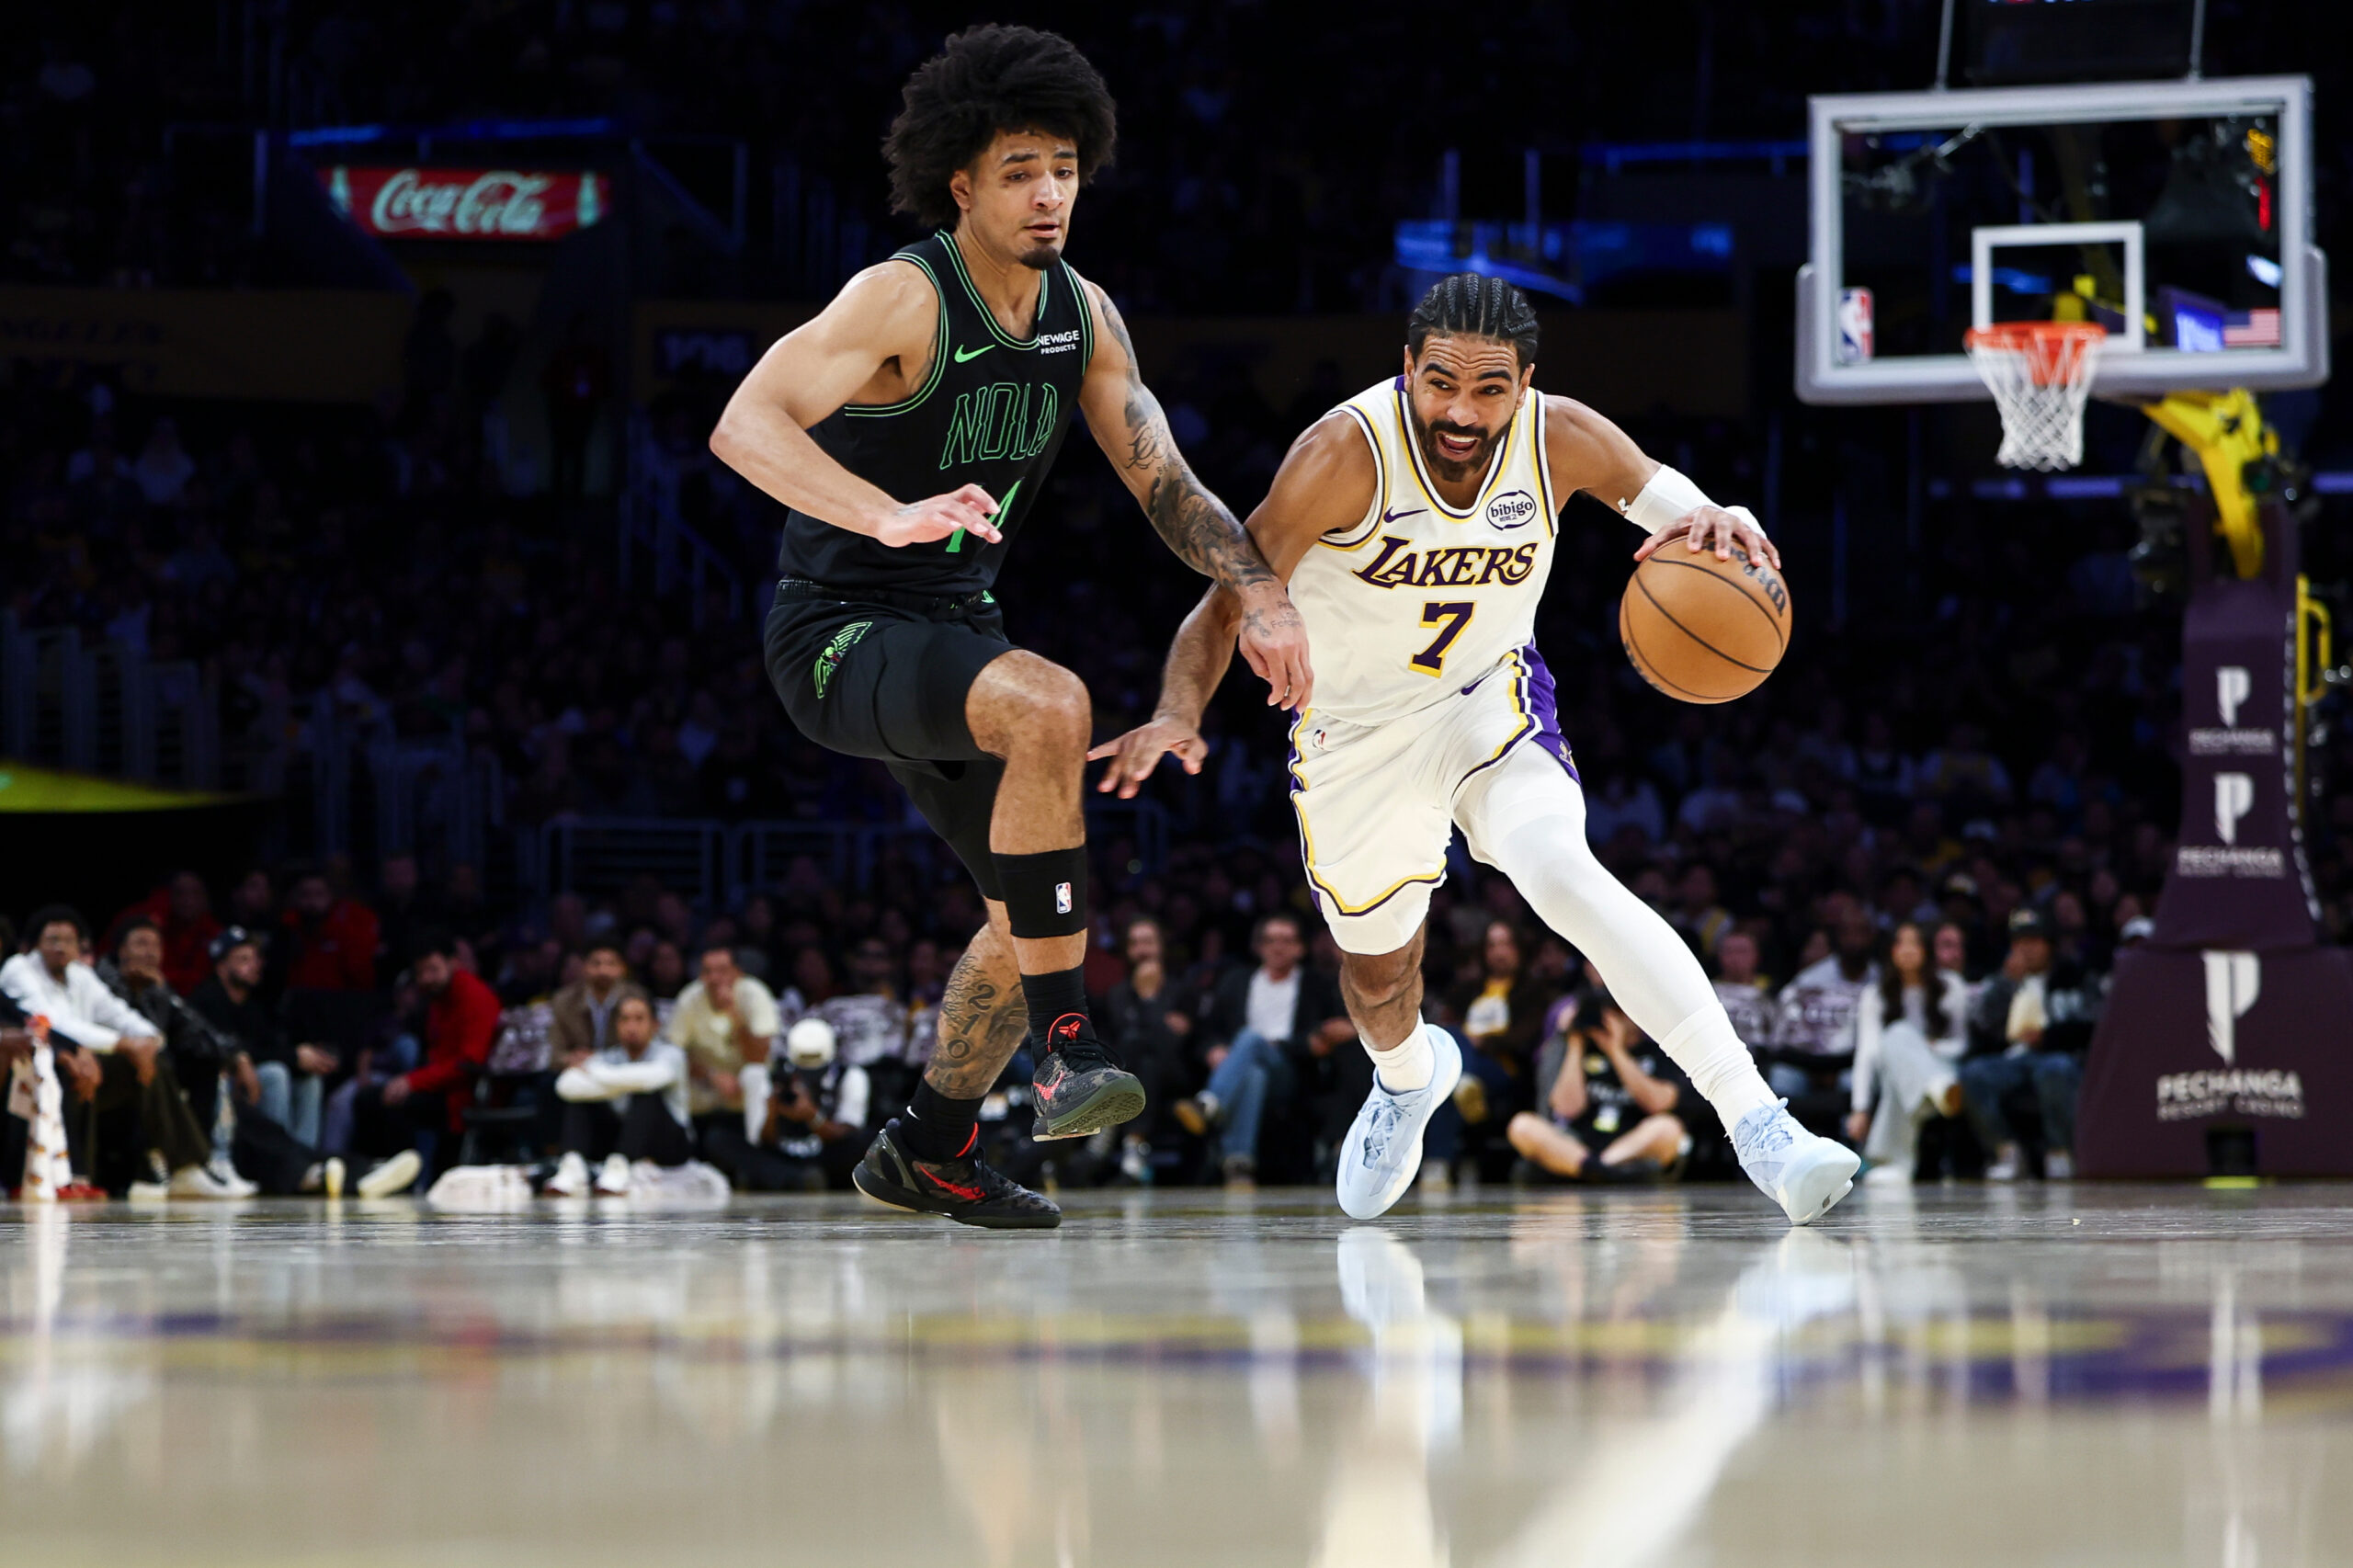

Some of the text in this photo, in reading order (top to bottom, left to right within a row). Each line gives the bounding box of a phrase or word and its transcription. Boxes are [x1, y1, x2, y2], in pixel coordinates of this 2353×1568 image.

[1040, 343, 1076, 355] PRODUCTS
[939, 382, 1058, 471] NOLA
[1490, 501, 1533, 517] bibigo
[1351, 534, 1540, 590] LAKERS
[1408, 600, 1478, 678] 7
[2156, 1069, 2302, 1102] PECHANGA
